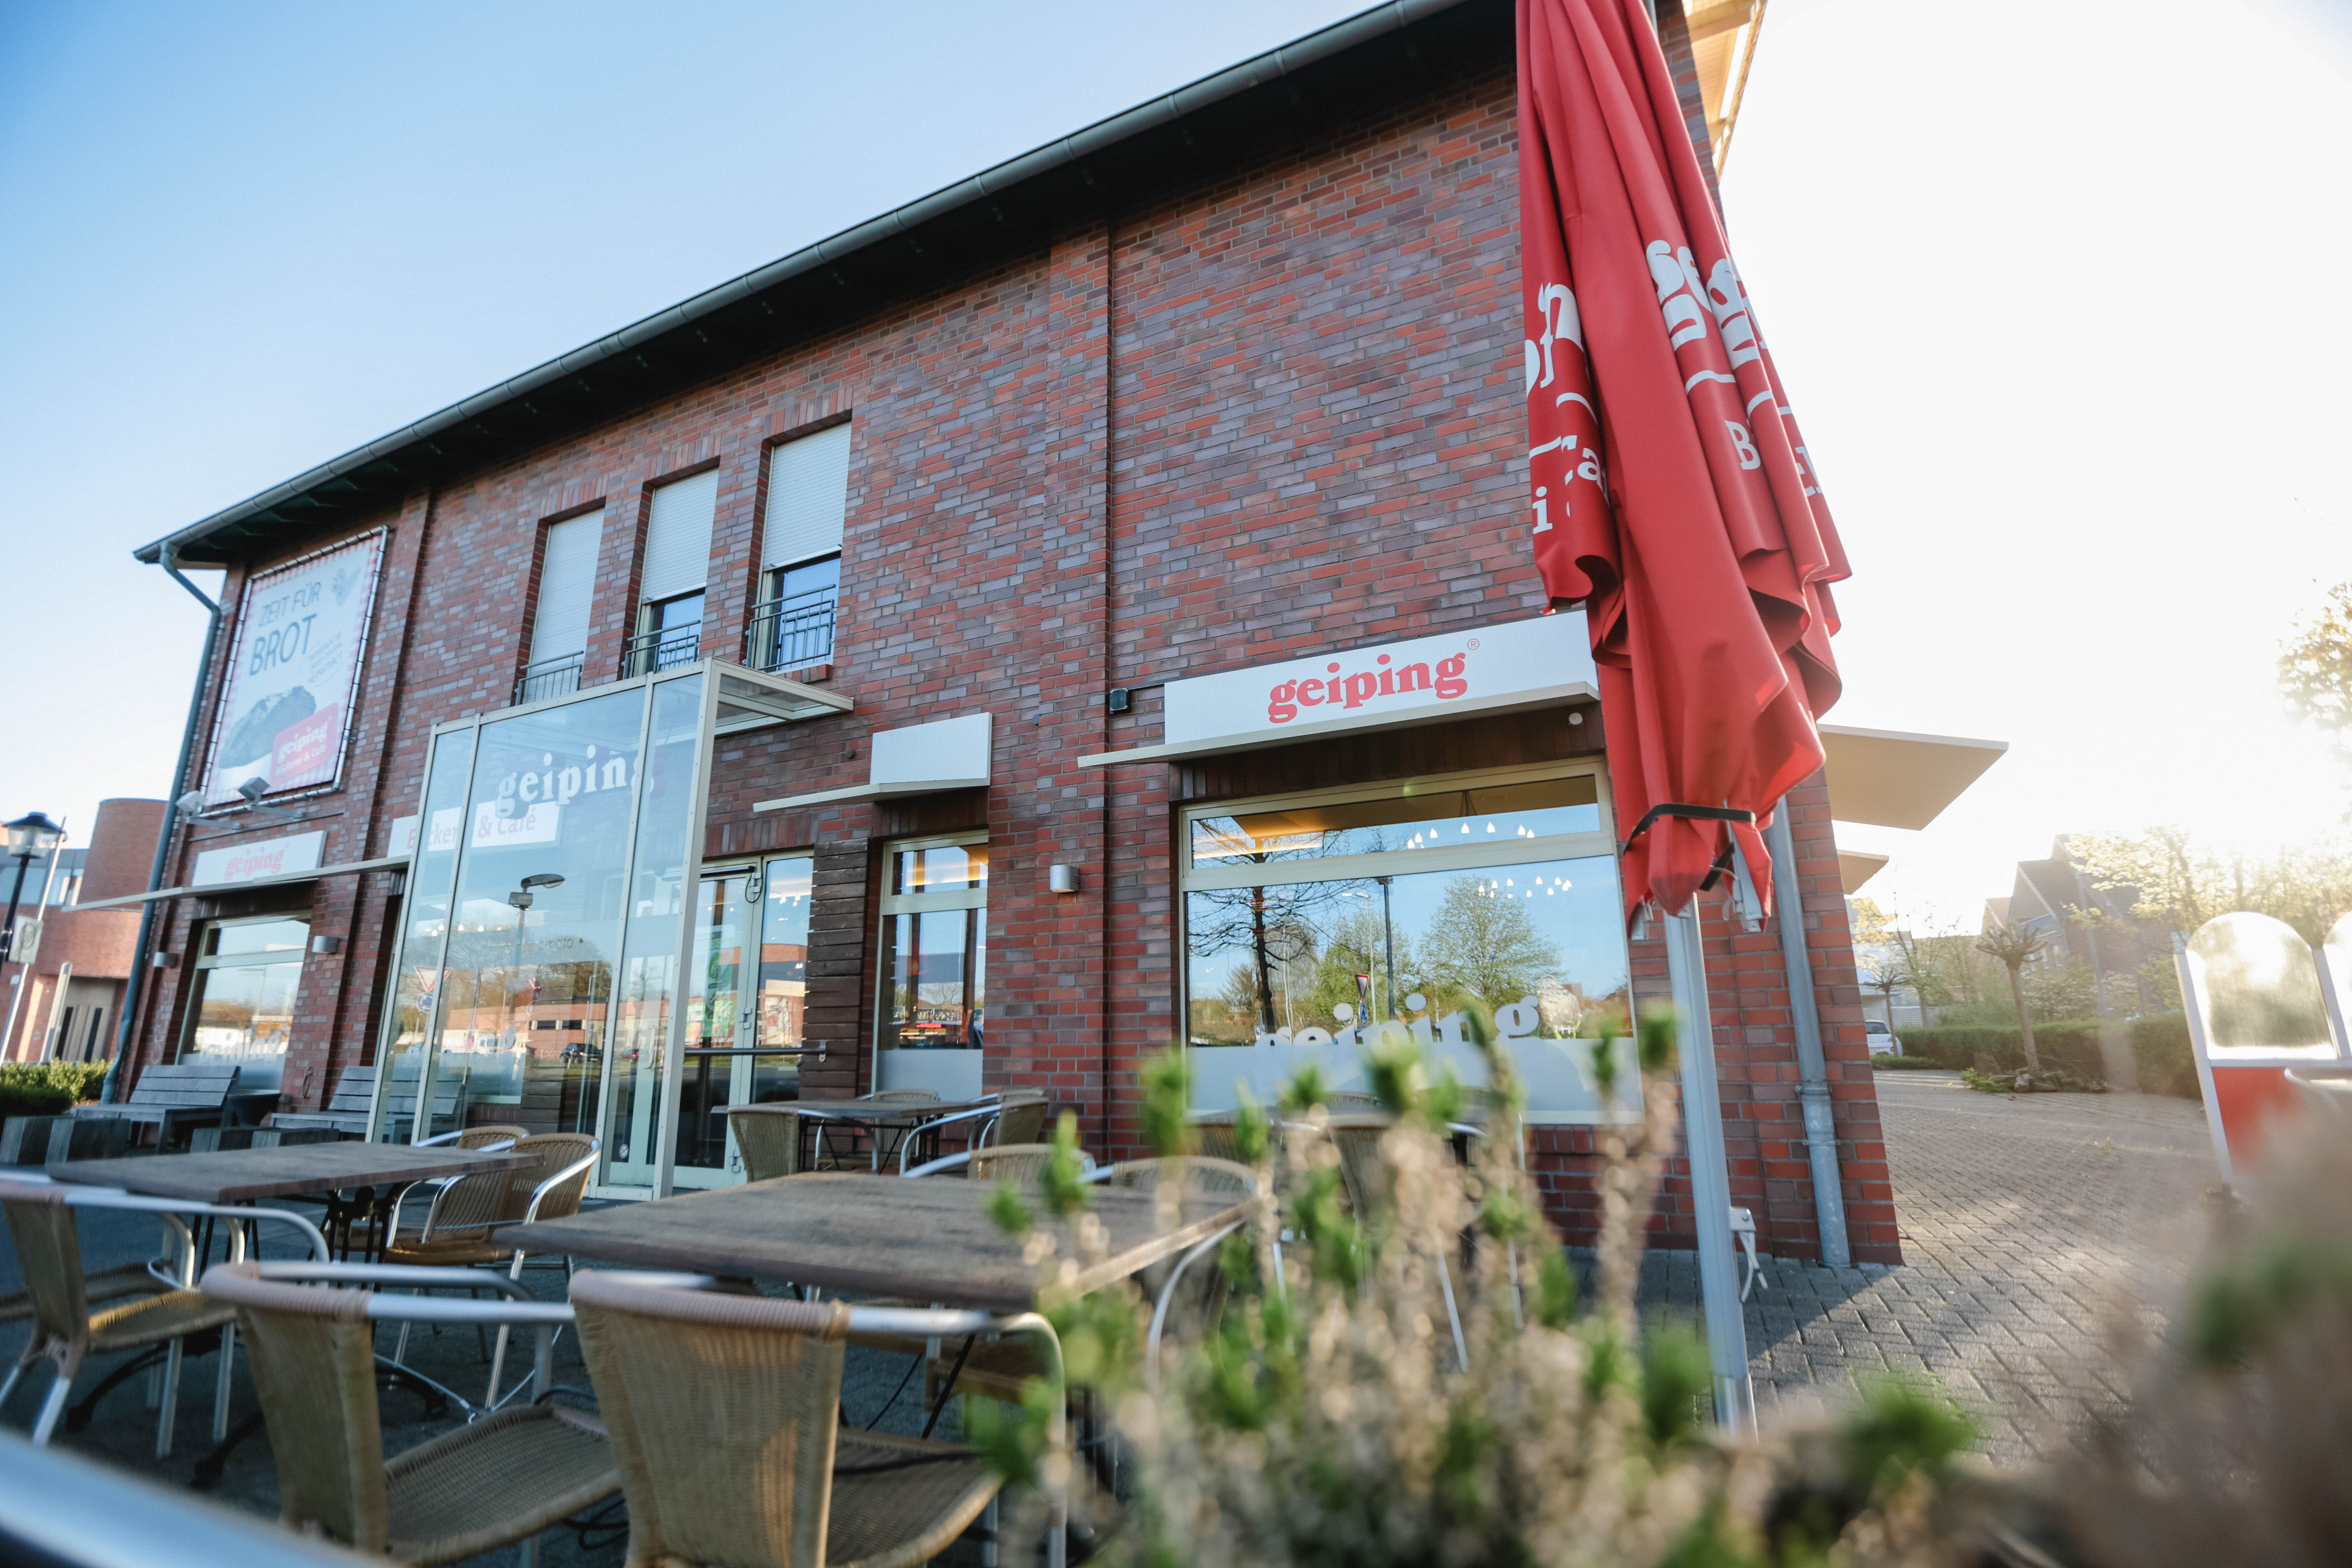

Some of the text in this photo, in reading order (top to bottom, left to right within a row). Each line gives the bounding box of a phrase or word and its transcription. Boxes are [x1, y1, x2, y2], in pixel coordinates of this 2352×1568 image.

[258, 581, 321, 627] ZEIT FÜR
[249, 613, 318, 676] BROT
[1268, 652, 1468, 724] geiping
[277, 722, 328, 764] geiping
[478, 815, 492, 838] &
[224, 846, 285, 881] geiping
